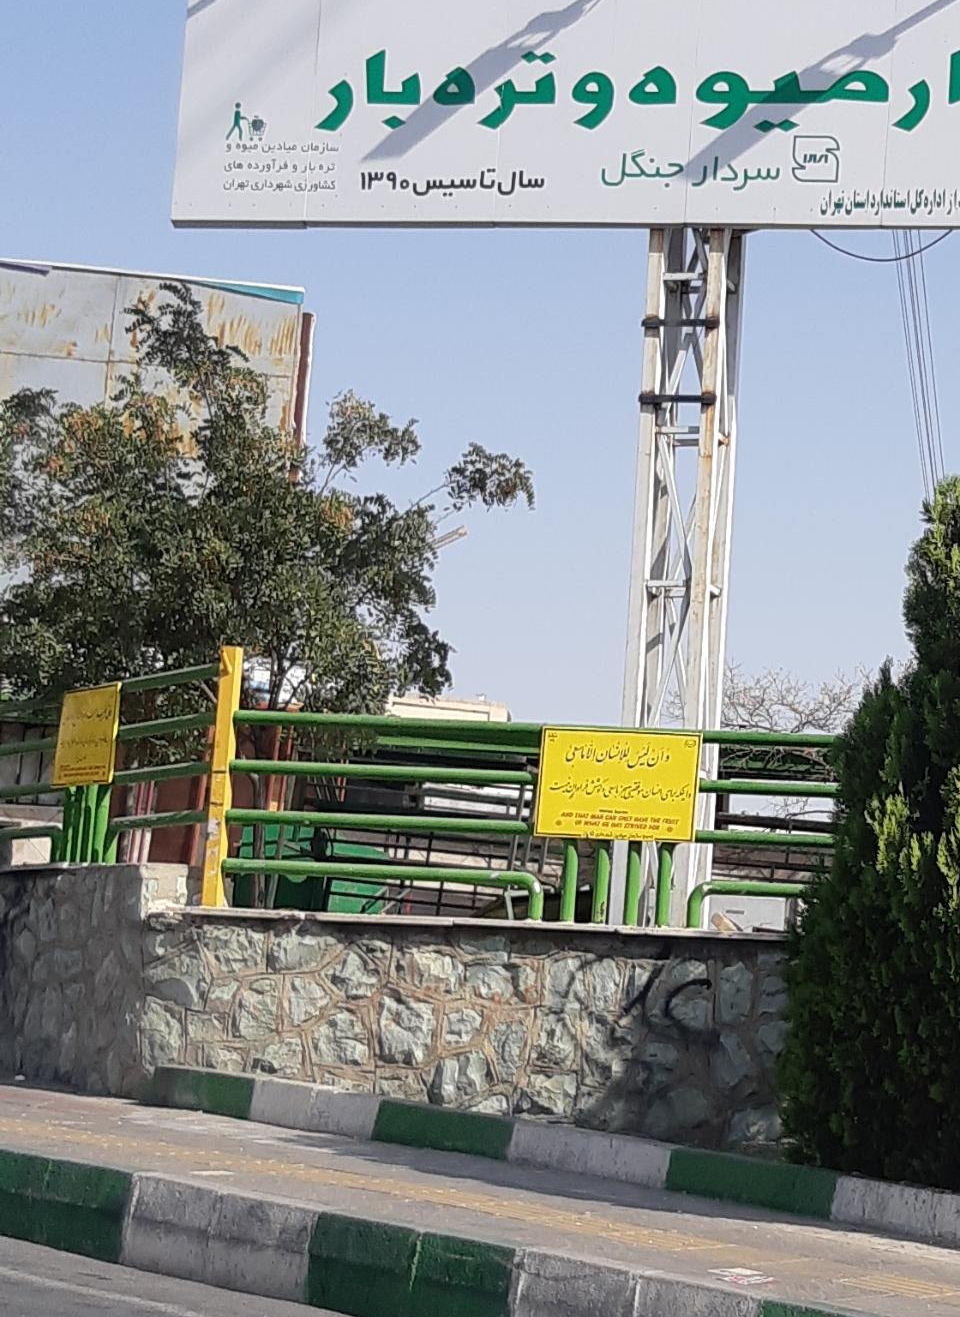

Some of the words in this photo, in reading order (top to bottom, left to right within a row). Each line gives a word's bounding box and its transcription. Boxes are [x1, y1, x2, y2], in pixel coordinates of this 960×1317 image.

[315, 50, 421, 132] بار
[434, 51, 557, 130] تره
[571, 71, 614, 130] و
[628, 66, 890, 132] میوه
[226, 143, 232, 153] و
[236, 143, 258, 153] میوه
[262, 142, 297, 153] میادین
[301, 142, 339, 154] سازمان
[291, 163, 298, 173] و
[600, 149, 684, 188] جنگل
[691, 155, 781, 191] سردار
[223, 179, 250, 191] تهران
[250, 180, 292, 192] شهرداری
[294, 181, 336, 192] کشاورزی
[413, 168, 496, 197] تاسیس
[498, 170, 545, 196] سال
[820, 189, 844, 216] تهران
[844, 188, 869, 216] استان
